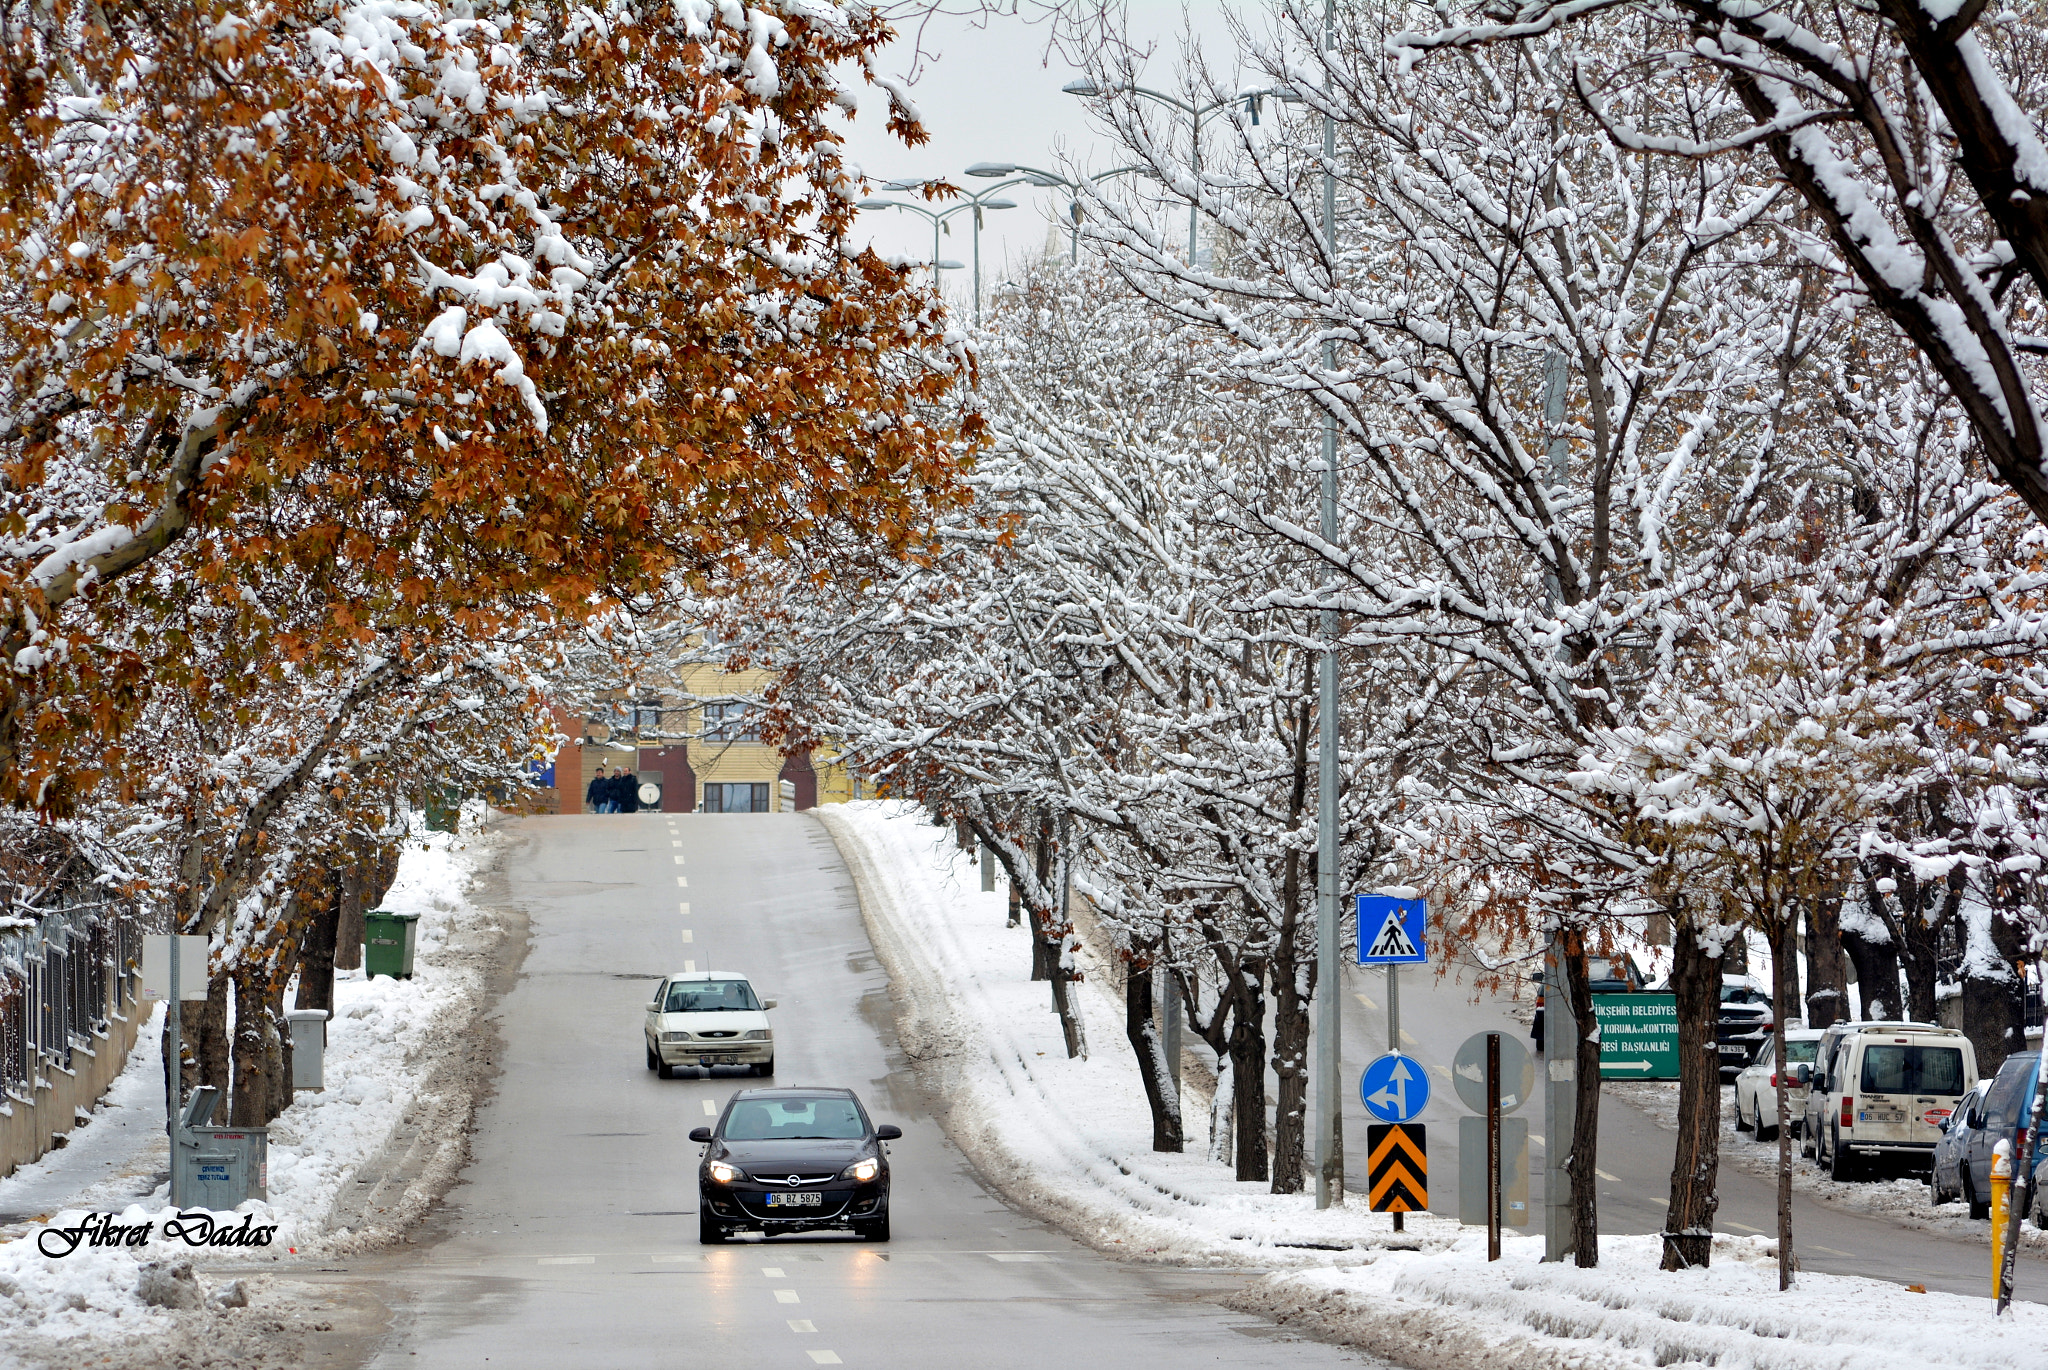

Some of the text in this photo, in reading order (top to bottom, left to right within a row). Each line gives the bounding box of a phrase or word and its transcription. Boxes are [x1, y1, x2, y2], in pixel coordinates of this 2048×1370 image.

[1594, 1003, 1630, 1018] ÜKŞEHİR
[1621, 1039, 1670, 1054] BAŞKANLIĞI
[1864, 1113, 1904, 1121] 06 HUC 57
[771, 1193, 821, 1204] 06 BZ 5875
